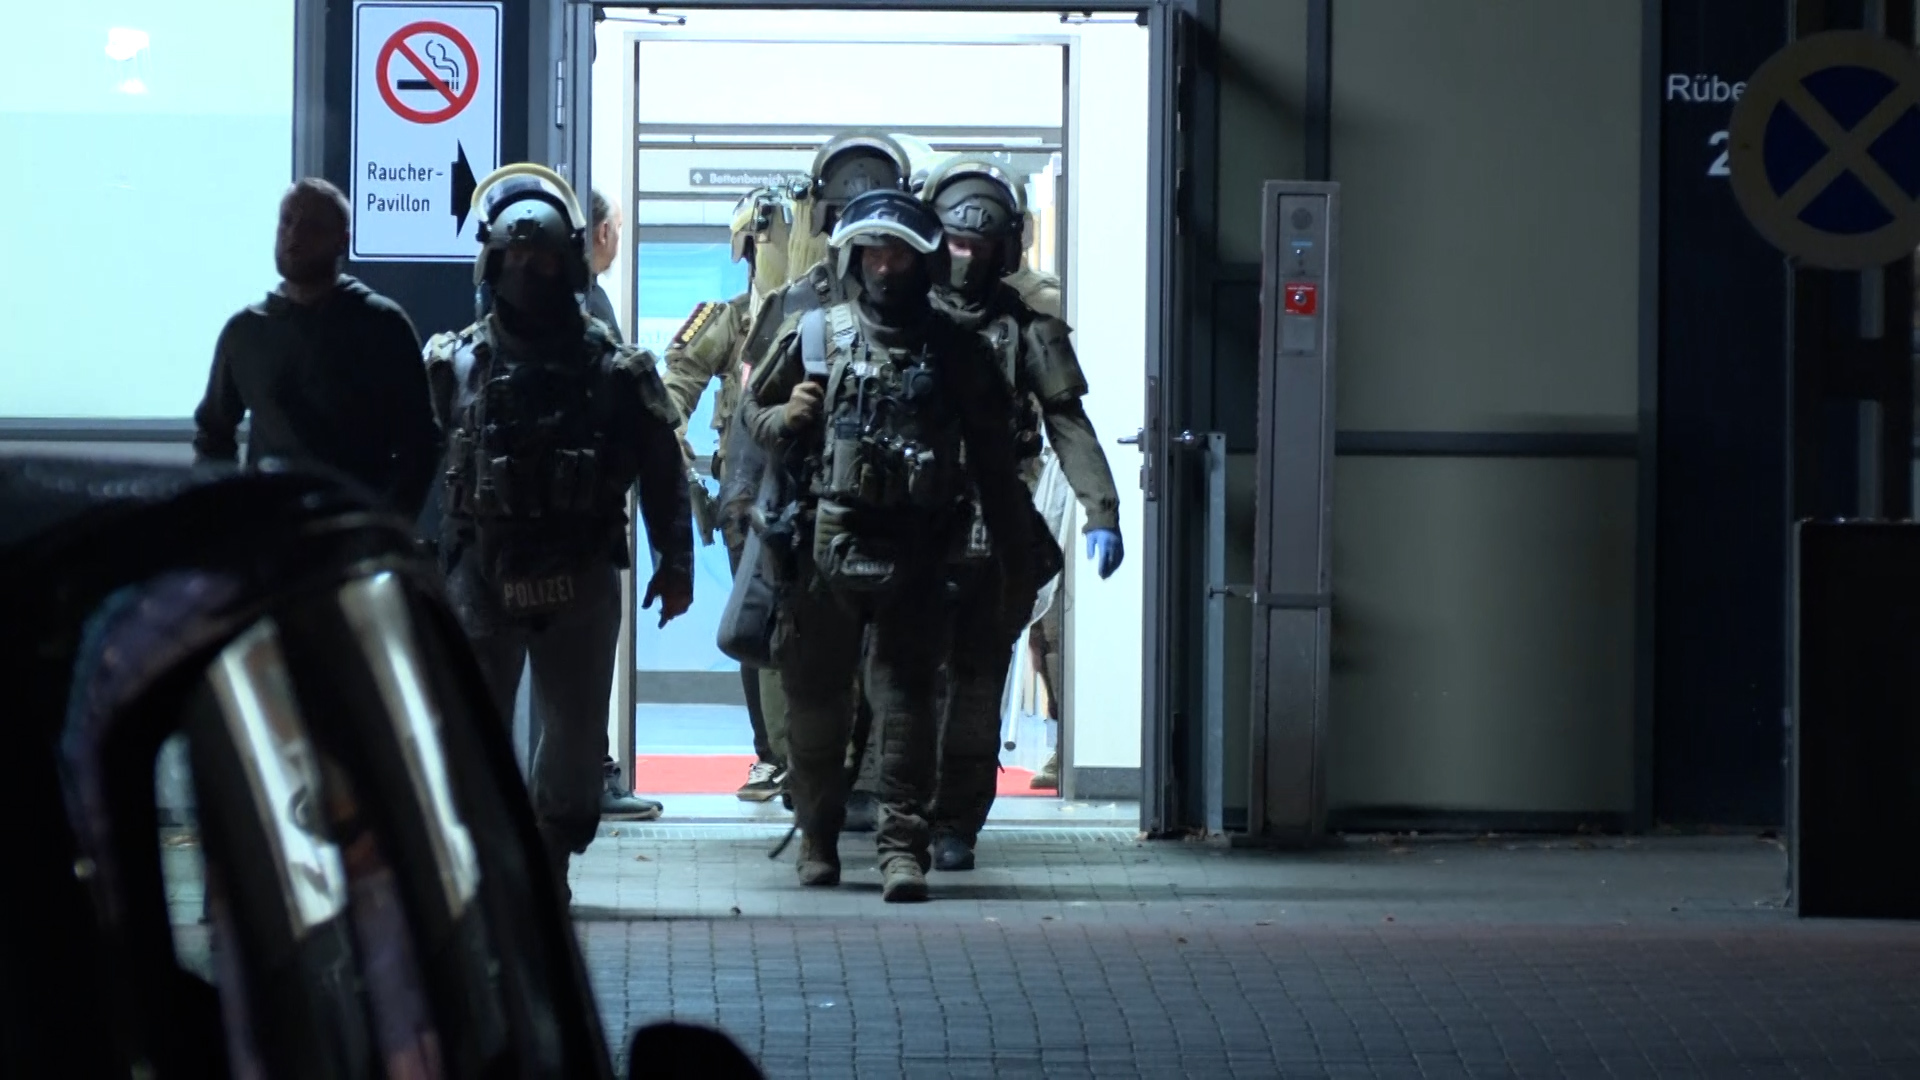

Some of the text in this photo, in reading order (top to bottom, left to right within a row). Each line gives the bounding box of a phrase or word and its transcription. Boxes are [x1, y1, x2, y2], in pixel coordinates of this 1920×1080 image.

[367, 161, 444, 182] Raucher-
[367, 193, 430, 212] Pavillon
[503, 574, 575, 608] POLIZEI
